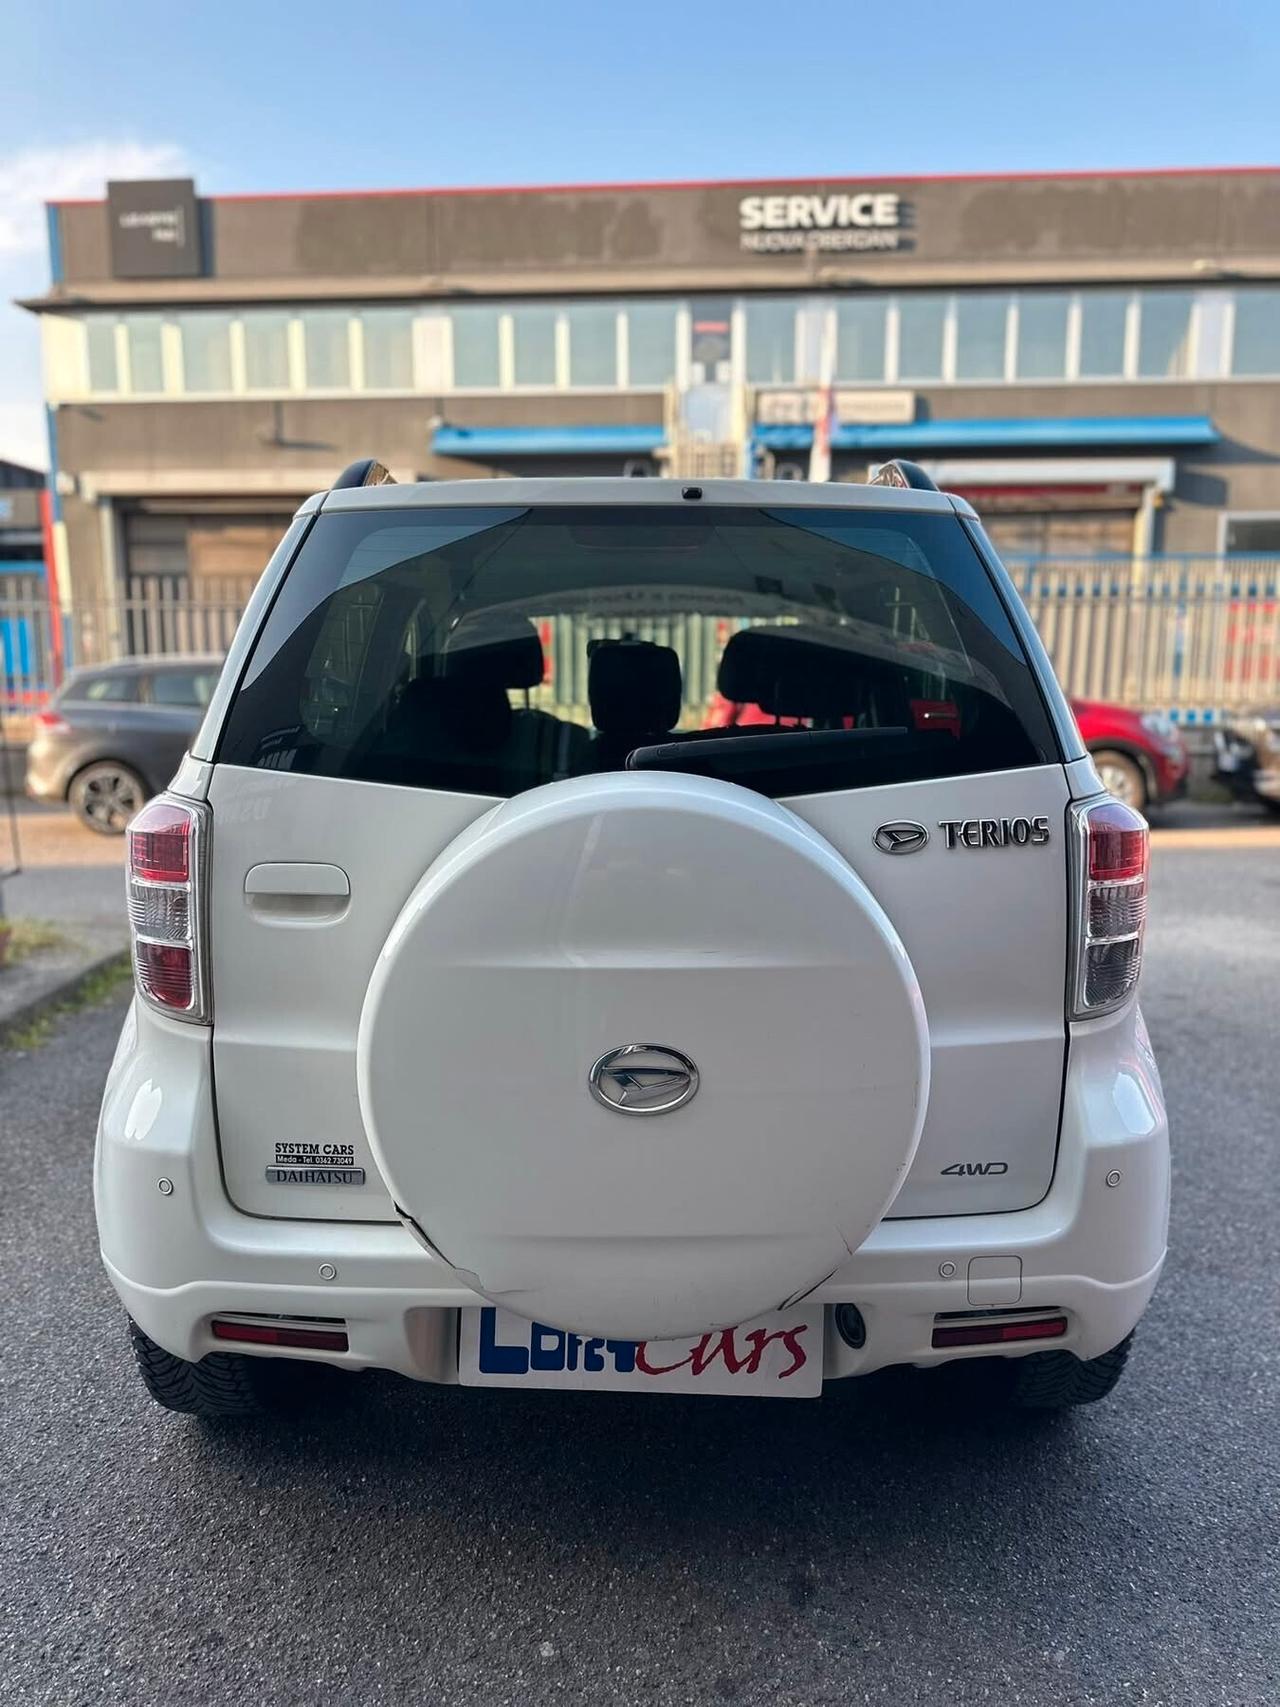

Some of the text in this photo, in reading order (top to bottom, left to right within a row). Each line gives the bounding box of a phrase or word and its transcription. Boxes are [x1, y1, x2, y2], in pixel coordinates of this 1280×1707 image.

[740, 194, 899, 228] SERVICE
[938, 816, 1051, 849] TERIOS
[275, 1142, 354, 1156] SYSTEM CARS
[277, 1155, 297, 1163] Meda
[940, 1162, 1008, 1176] 4WD
[276, 1170, 352, 1184] DAIHATSU
